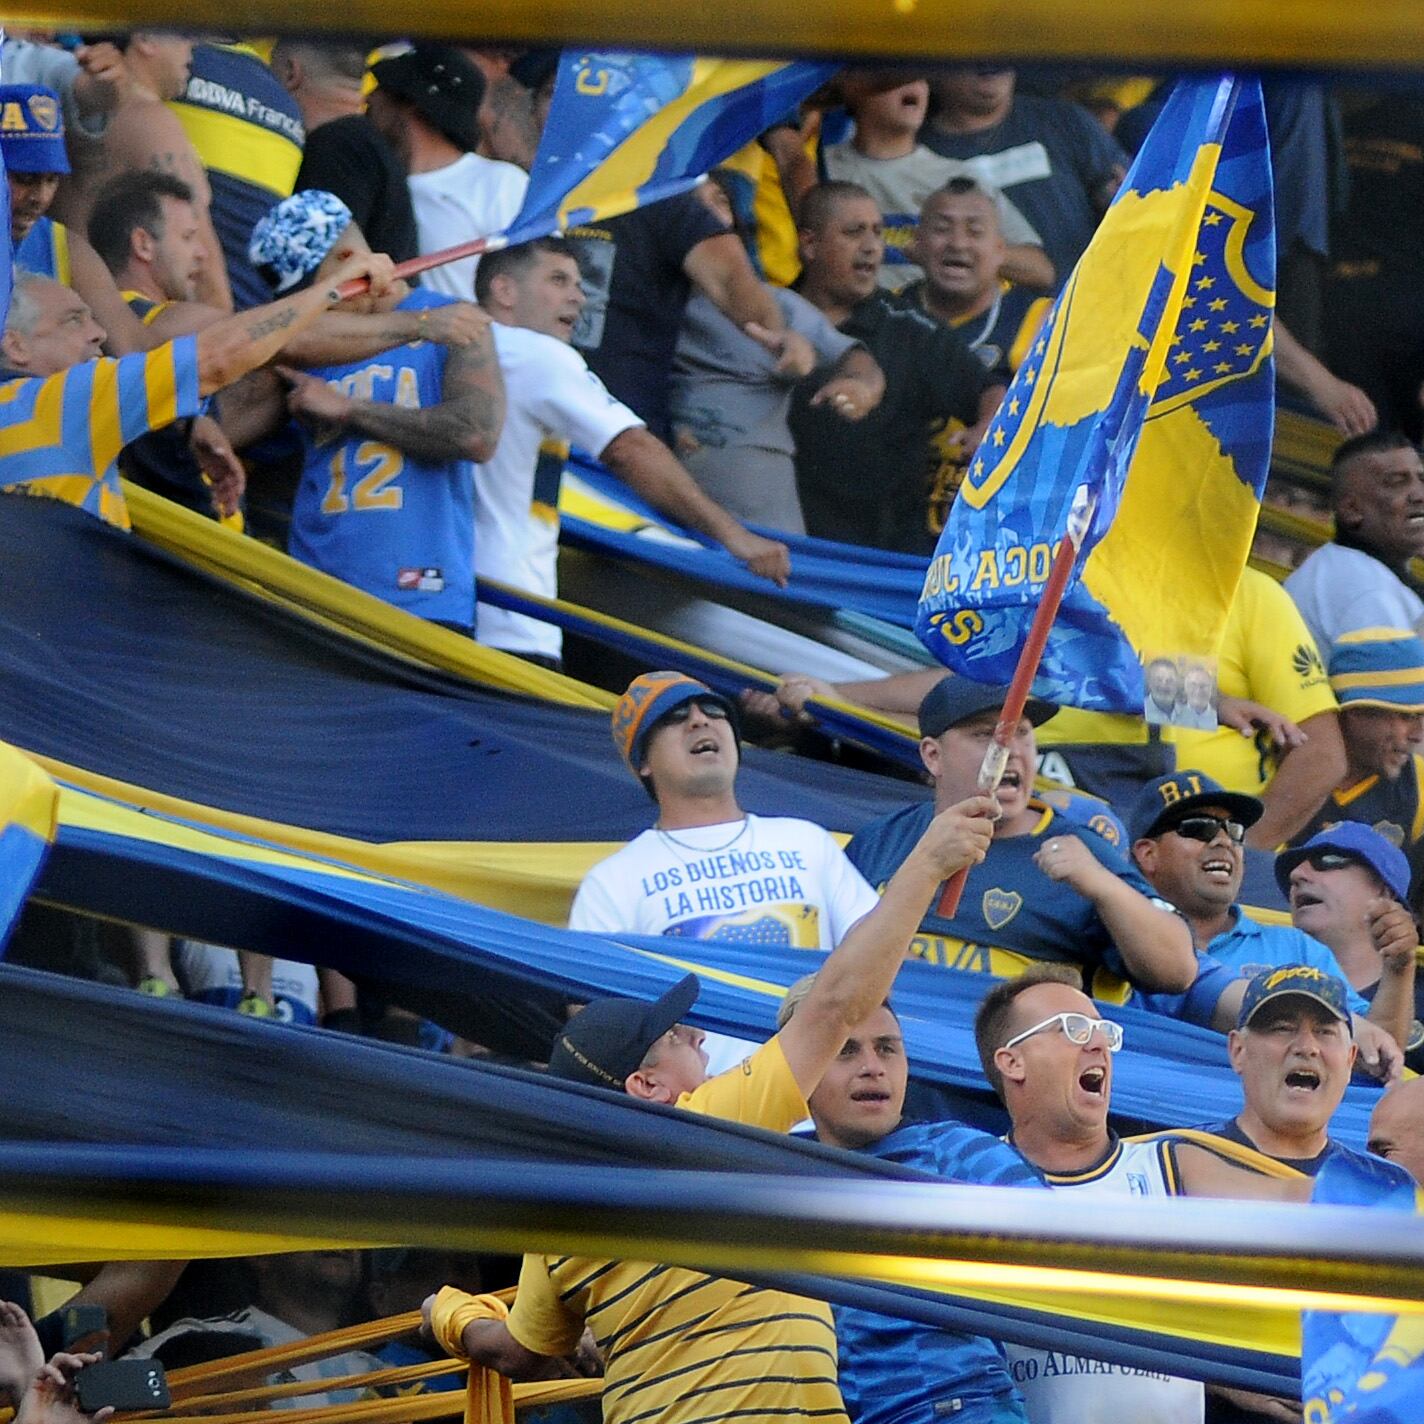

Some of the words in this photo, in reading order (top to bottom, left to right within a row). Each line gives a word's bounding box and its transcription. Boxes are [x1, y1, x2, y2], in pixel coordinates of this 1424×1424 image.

[319, 440, 404, 516] 12
[642, 867, 683, 897] LOS
[685, 849, 776, 883] DUEÑOS
[778, 850, 807, 871] DE
[664, 891, 694, 919] LA
[696, 876, 805, 912] HISTORIA
